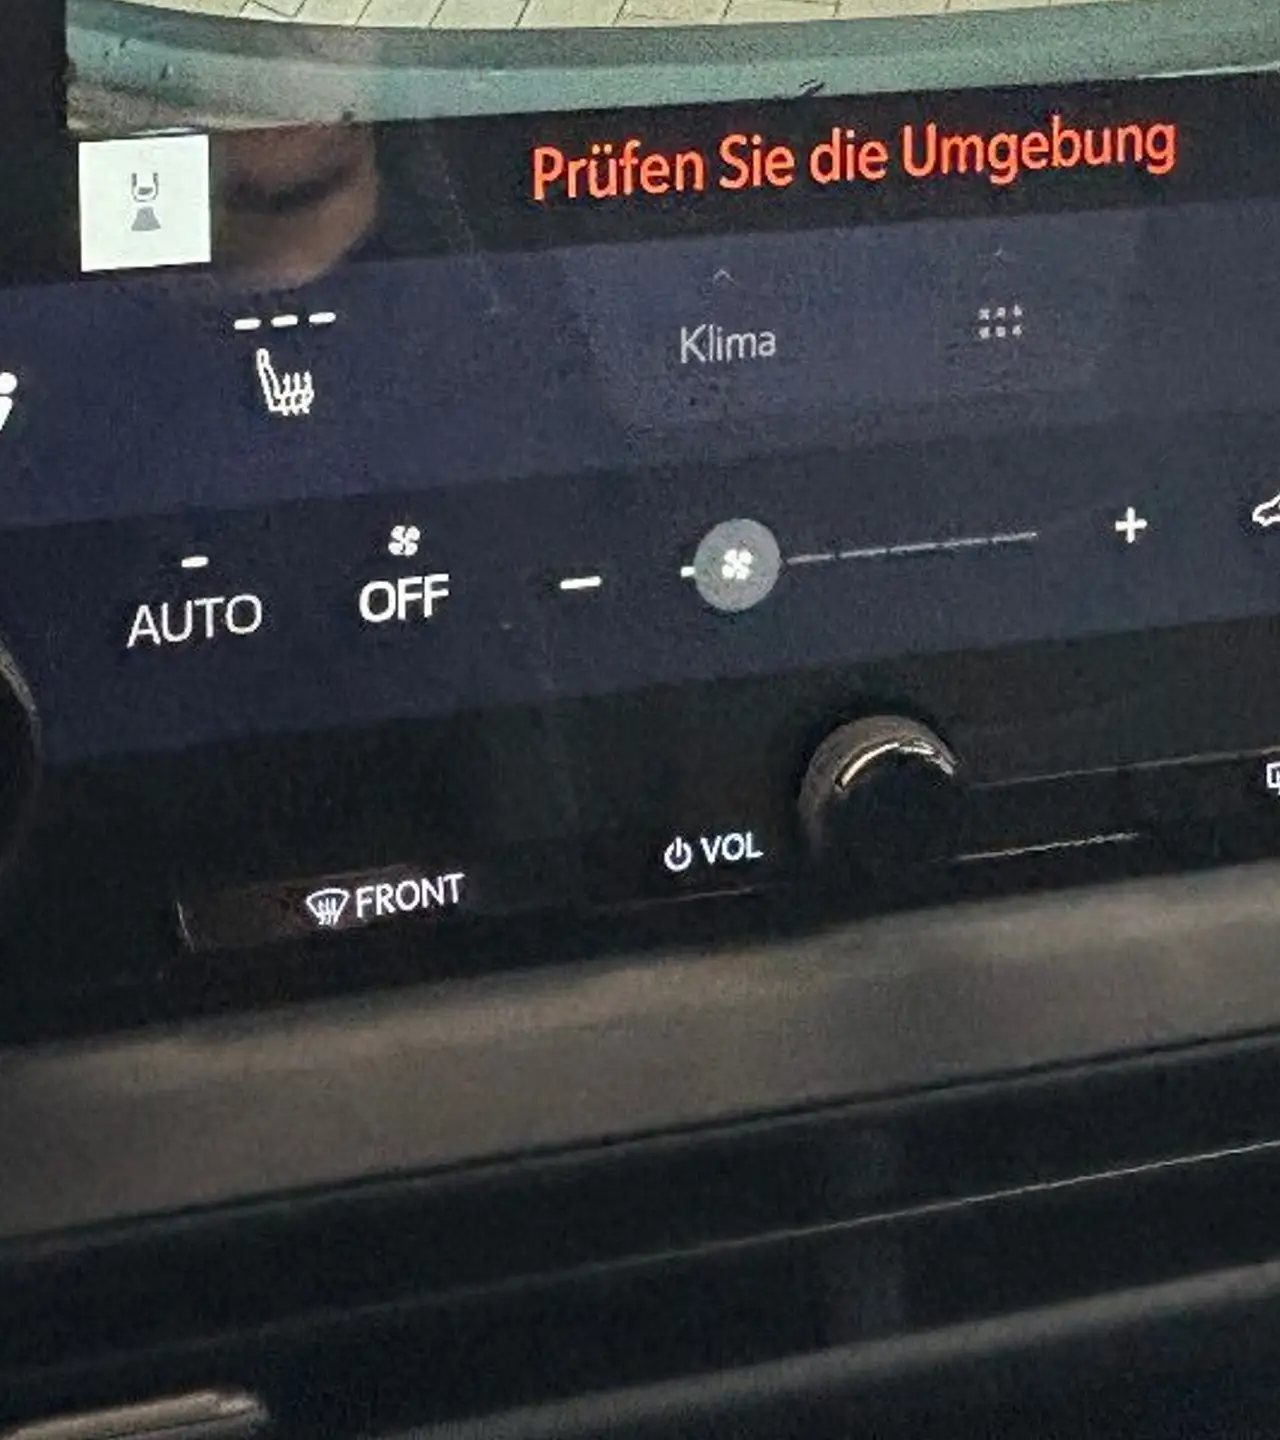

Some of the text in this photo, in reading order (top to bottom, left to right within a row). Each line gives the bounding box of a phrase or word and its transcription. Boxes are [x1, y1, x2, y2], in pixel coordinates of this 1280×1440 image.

[533, 114, 1177, 201] Prüfen Sie die Umgebung
[679, 323, 777, 364] Klima
[125, 593, 263, 648] AUTO
[358, 572, 450, 624] OFF
[699, 830, 764, 866] VOL
[354, 871, 466, 919] FRONT
